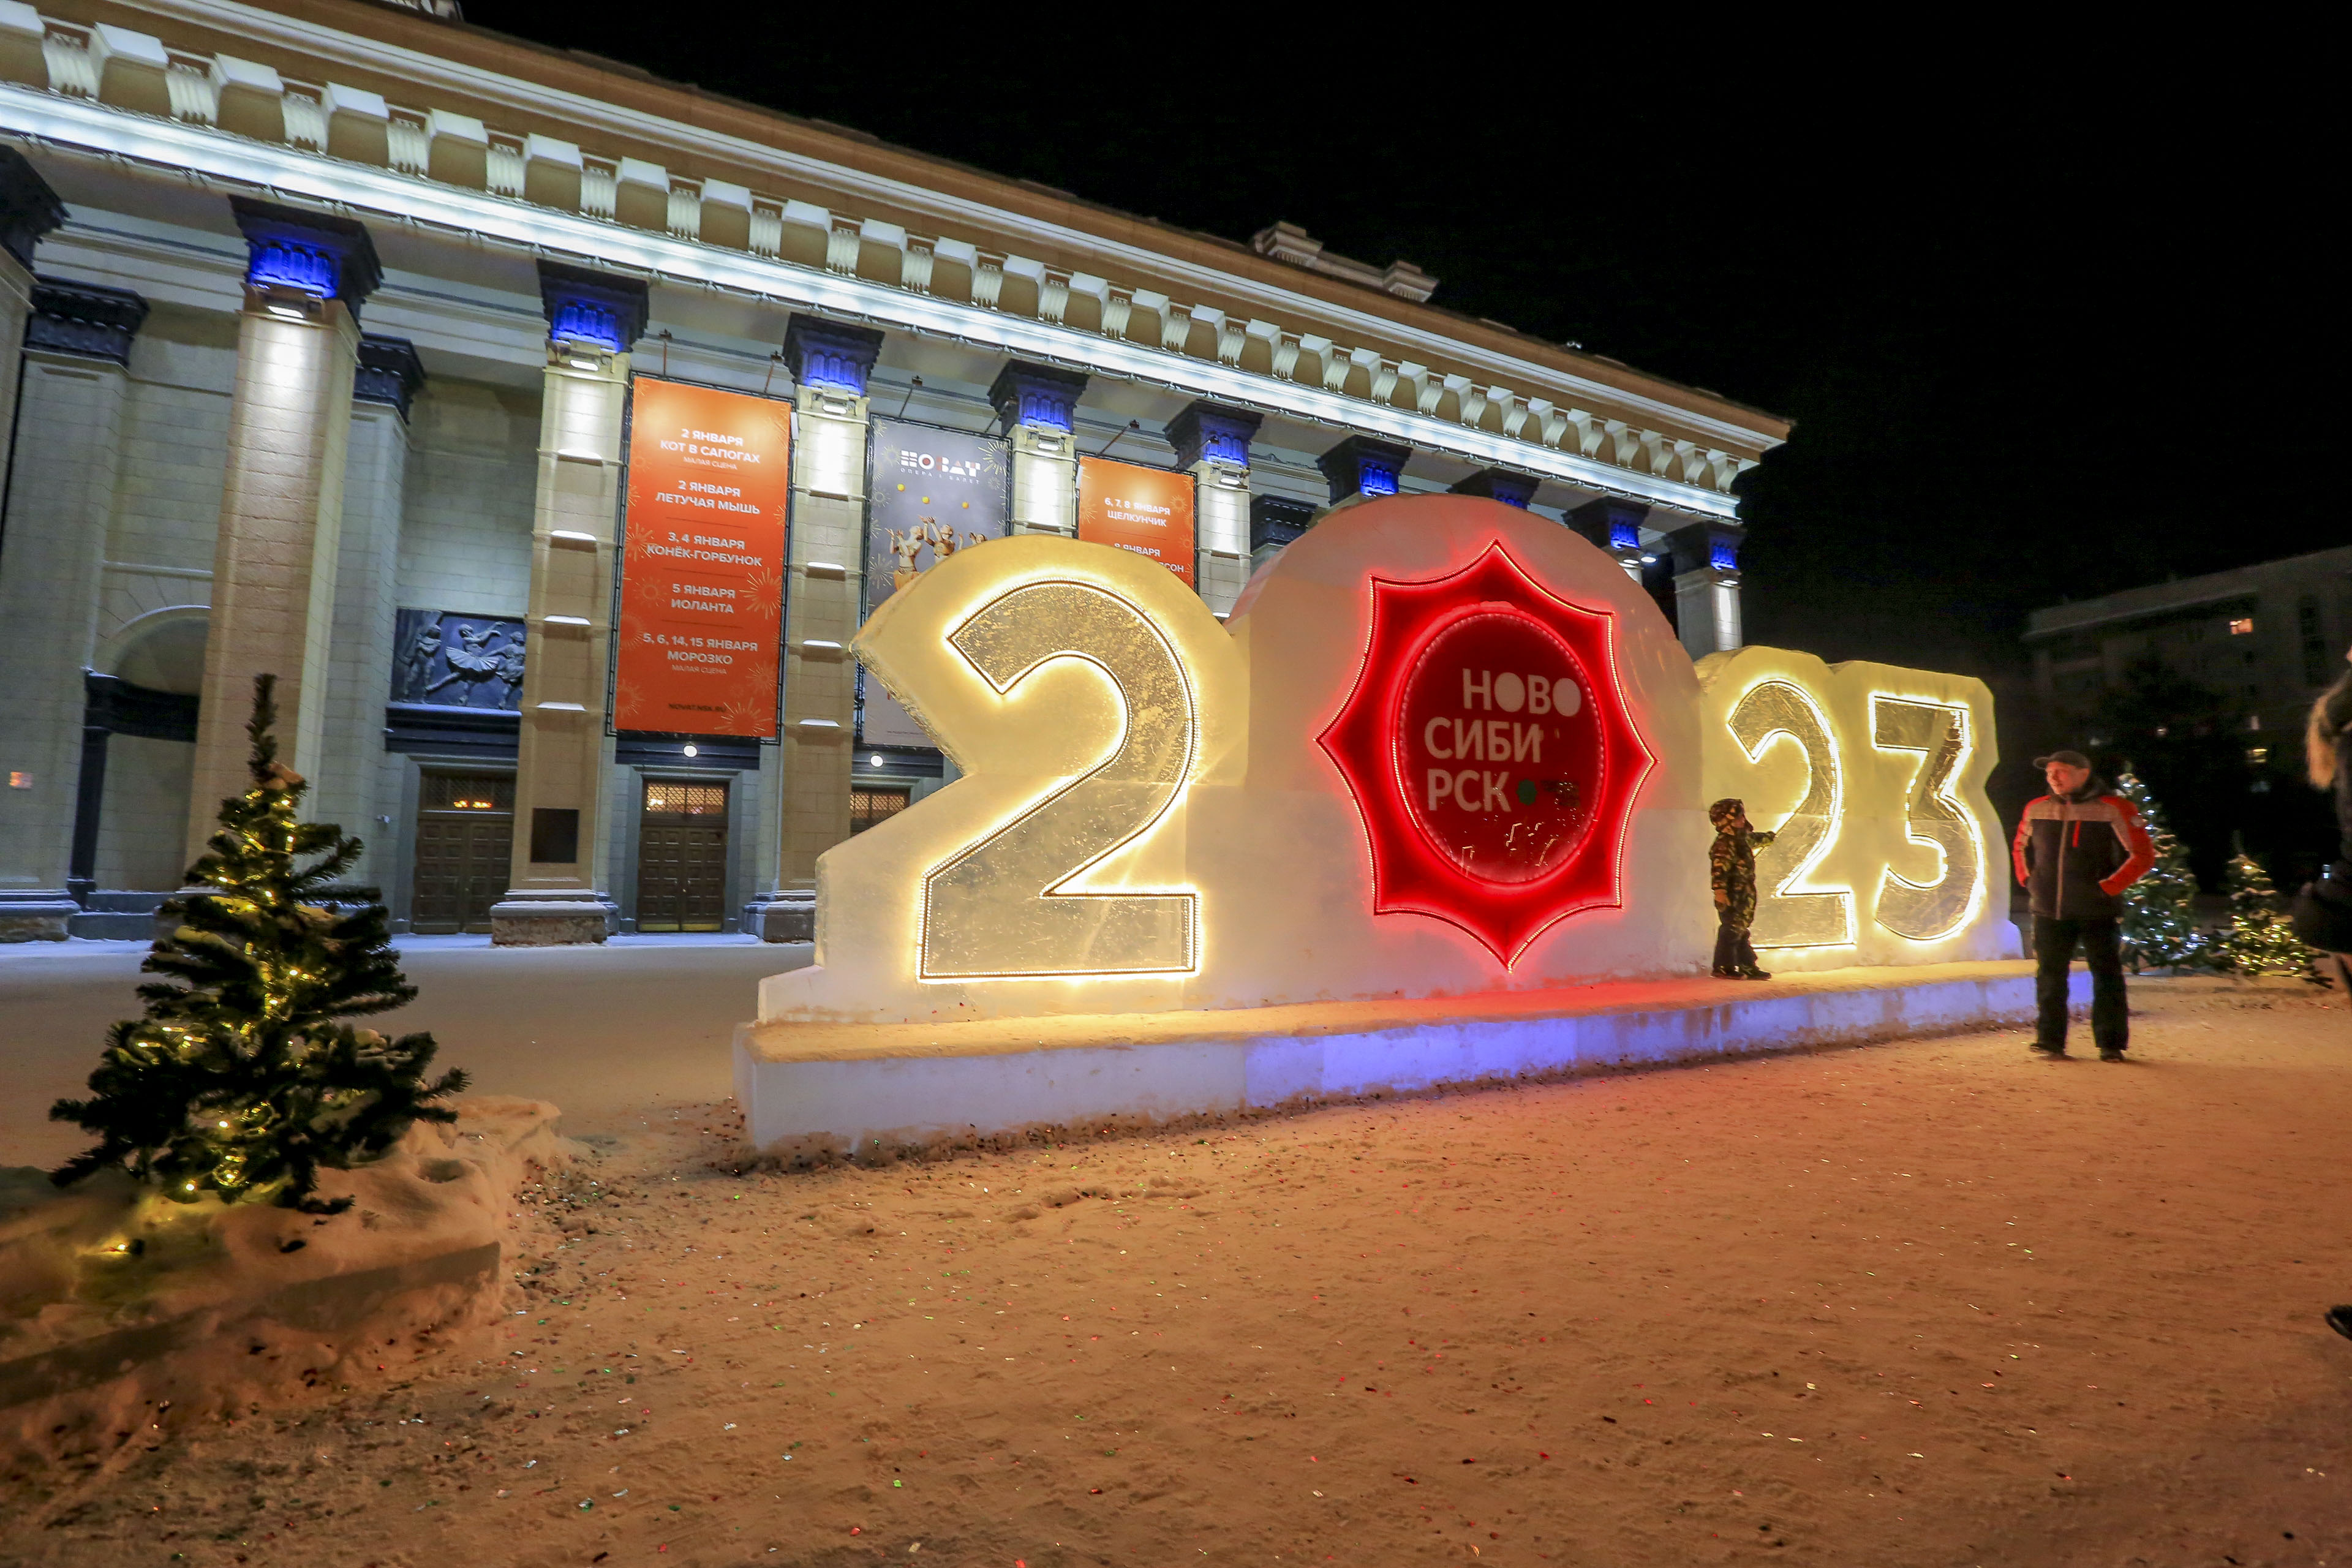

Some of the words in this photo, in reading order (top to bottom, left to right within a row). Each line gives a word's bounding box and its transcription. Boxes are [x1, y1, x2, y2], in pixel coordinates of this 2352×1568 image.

[681, 429, 690, 439] 2
[692, 430, 744, 447] ЯНВАРЯ
[660, 440, 686, 452] КОТ
[689, 444, 698, 454] В
[701, 446, 760, 463] САПОГАХ
[683, 456, 710, 466] МАЛАЯ
[712, 461, 737, 470] СЦЕНА
[678, 480, 687, 490] 2
[689, 481, 741, 497] ЯНВАРЯ
[655, 492, 715, 508] ЛЕТУЧАЯ
[718, 500, 760, 514] МЫШЬ
[1104, 497, 1114, 507] 6,
[1115, 499, 1121, 508] 7,
[1124, 500, 1131, 509] 8
[1133, 502, 1170, 516] ЯНВАРЯ
[1107, 510, 1167, 527] ЩЕЛКУНЧИК
[668, 532, 679, 543] 3,
[681, 533, 690, 543] 4
[693, 535, 745, 549] ЯНВАРЯ
[647, 544, 762, 567] КОНЁК-ГОРБУНОК
[673, 583, 681, 593] 5
[684, 585, 735, 598] ЯНВАРЯ
[671, 598, 734, 614] ИОЛАНТА
[643, 633, 655, 644] 5,
[657, 634, 669, 646] 6,
[671, 635, 688, 647] 14,
[690, 637, 703, 647] 15
[707, 638, 758, 652] ЯНВАРЯ
[667, 650, 733, 665] МОРОЗКО
[1462, 668, 1581, 717] НОВО
[1424, 717, 1541, 763] СИБИ
[1427, 768, 1512, 812] РСК
